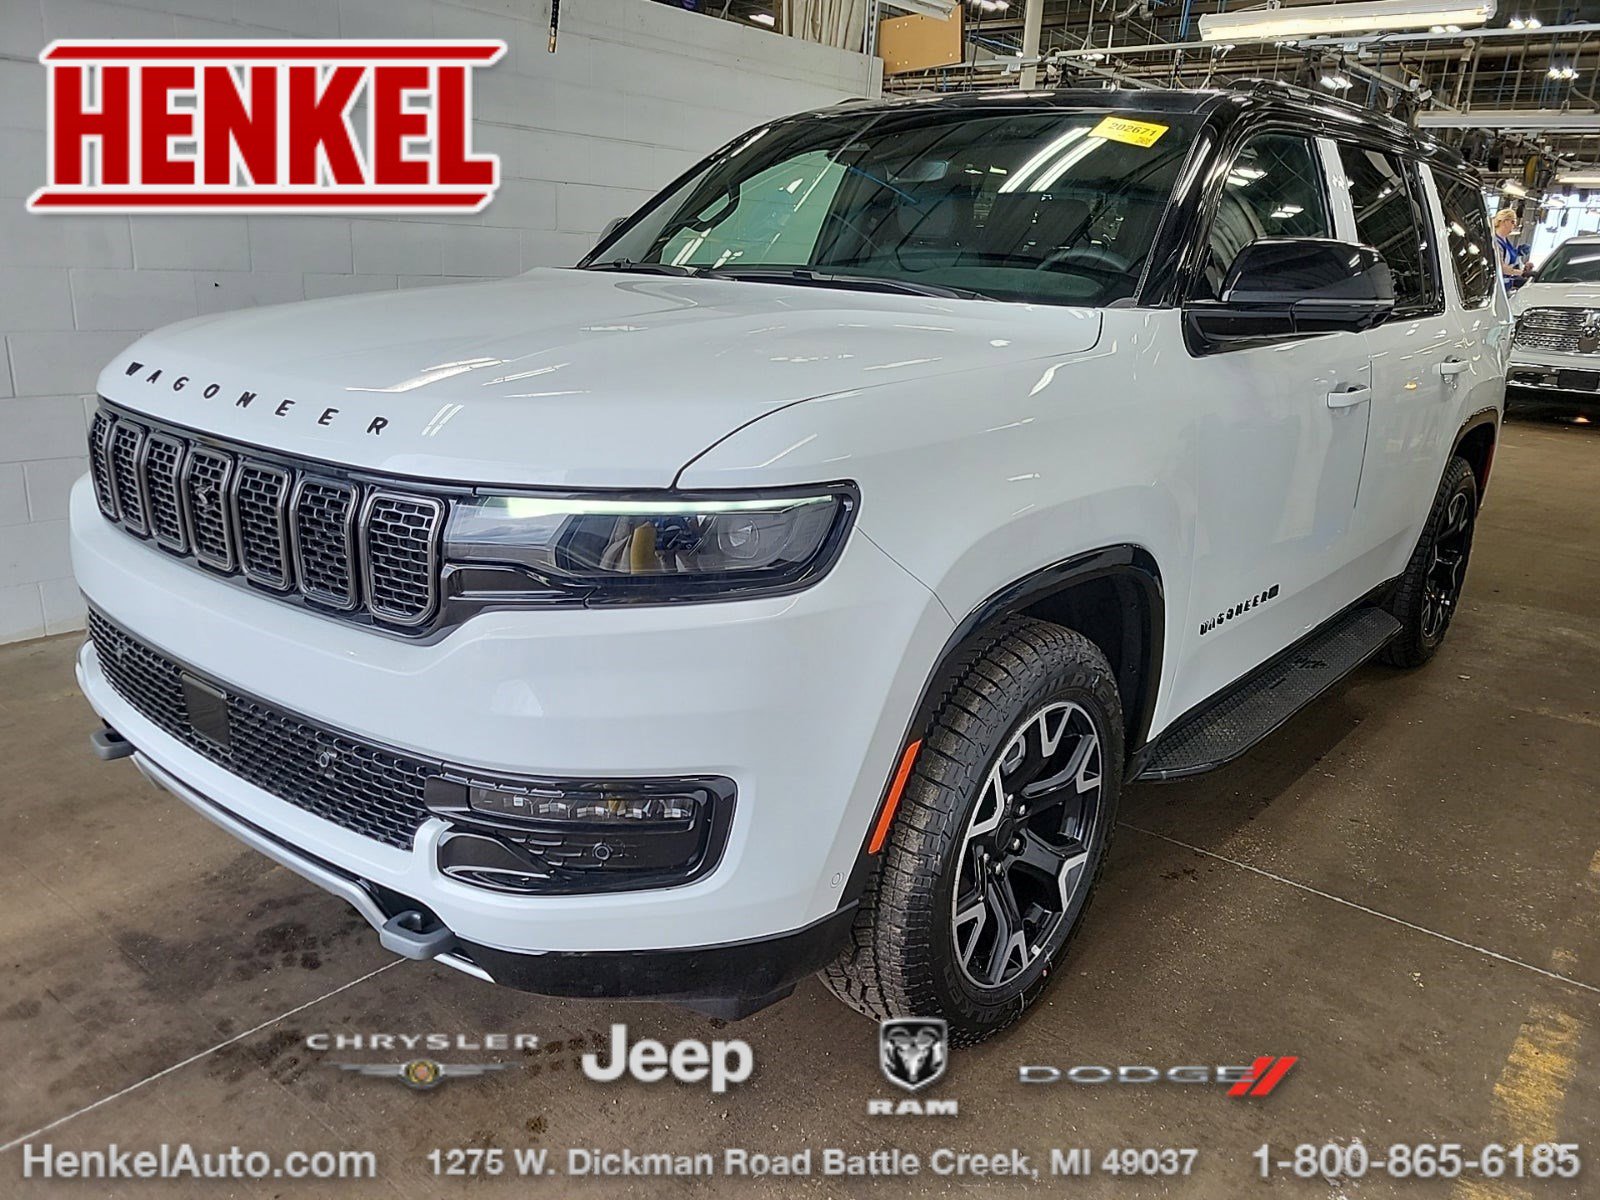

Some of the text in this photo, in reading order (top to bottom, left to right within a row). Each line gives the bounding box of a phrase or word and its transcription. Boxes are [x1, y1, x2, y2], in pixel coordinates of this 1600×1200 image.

[1108, 122, 1157, 137] 202671
[125, 361, 389, 436] WAGONEER
[1200, 591, 1268, 635] WAGONEER
